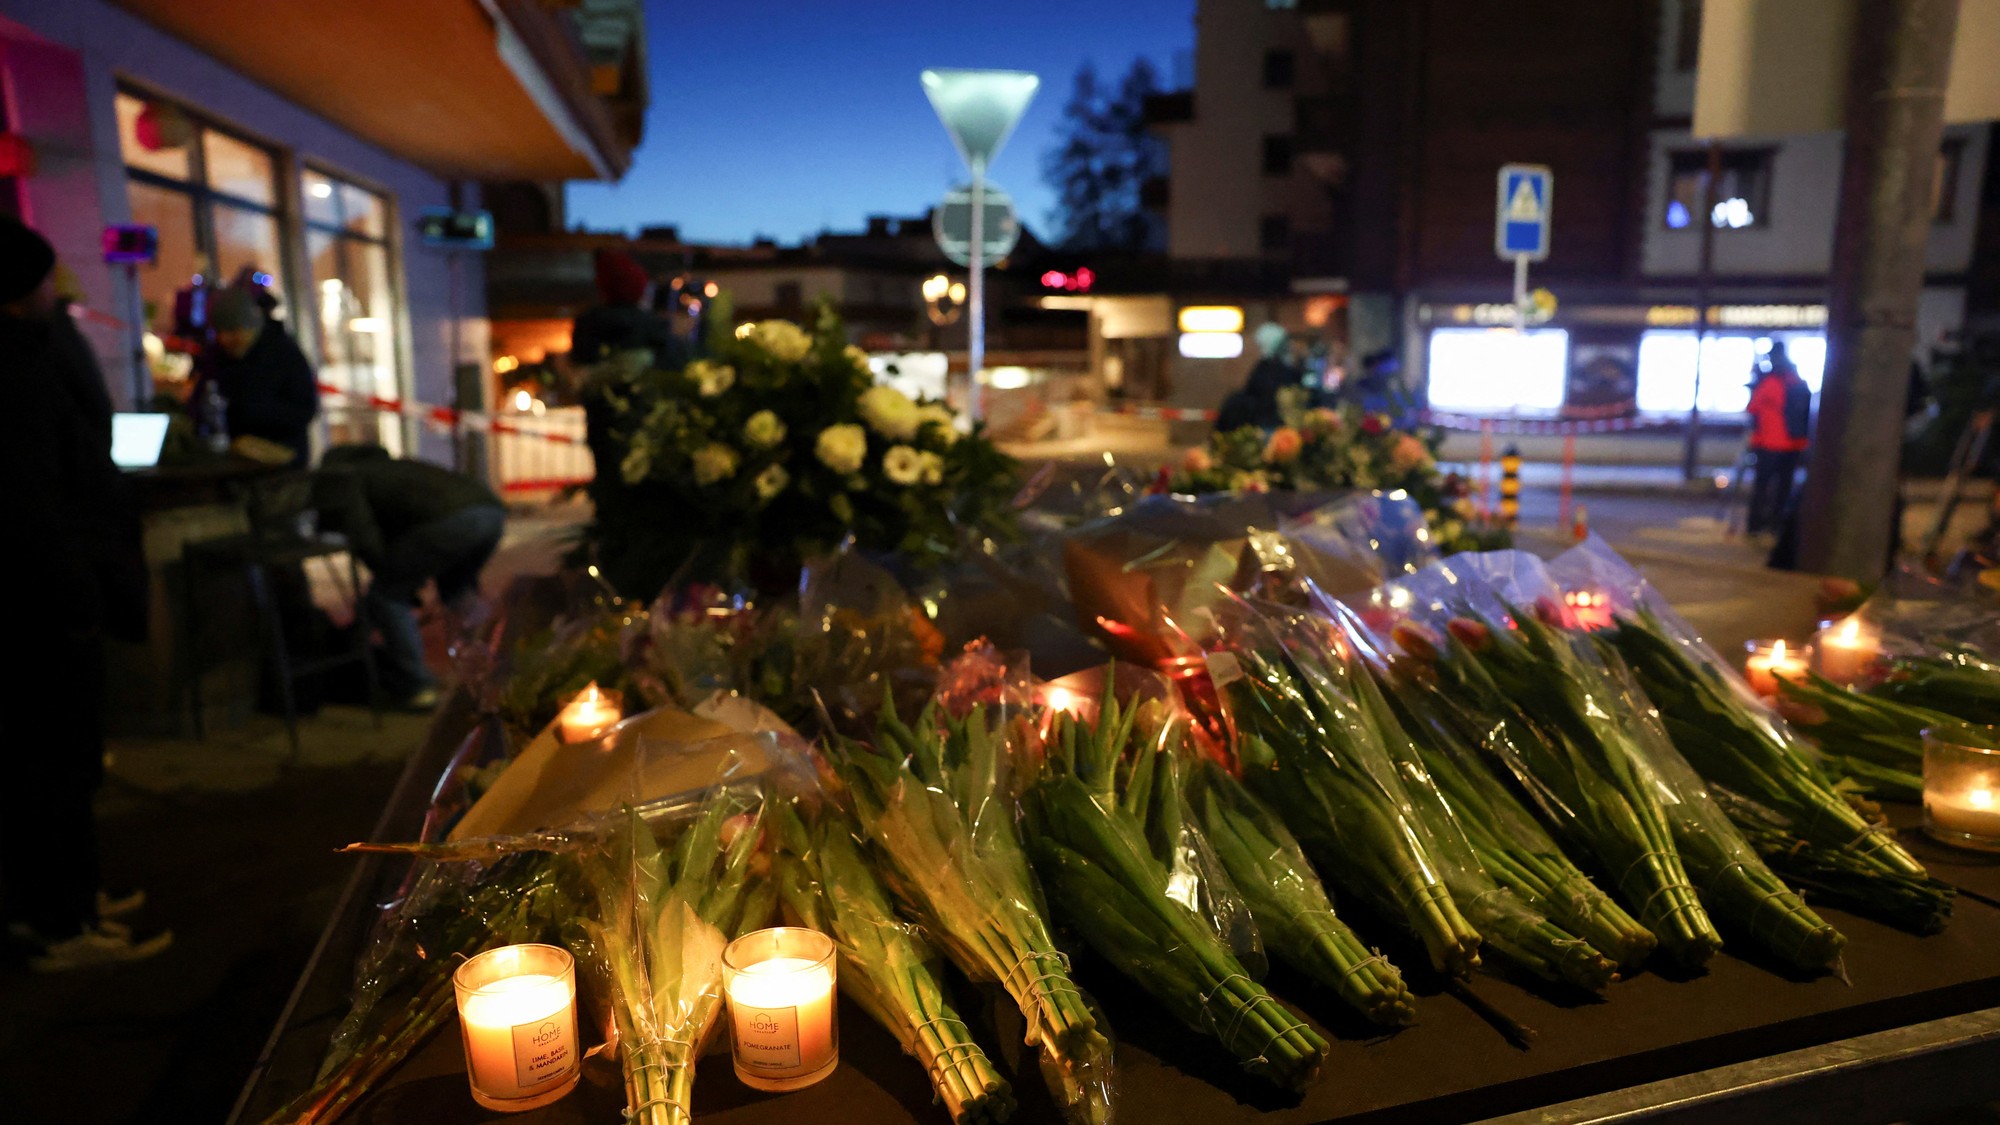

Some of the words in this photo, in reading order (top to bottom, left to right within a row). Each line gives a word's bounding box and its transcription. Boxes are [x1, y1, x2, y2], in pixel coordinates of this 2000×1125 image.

[749, 1021, 779, 1030] HOME
[532, 1027, 562, 1044] HOME
[743, 1041, 791, 1051] POMEGRANATE
